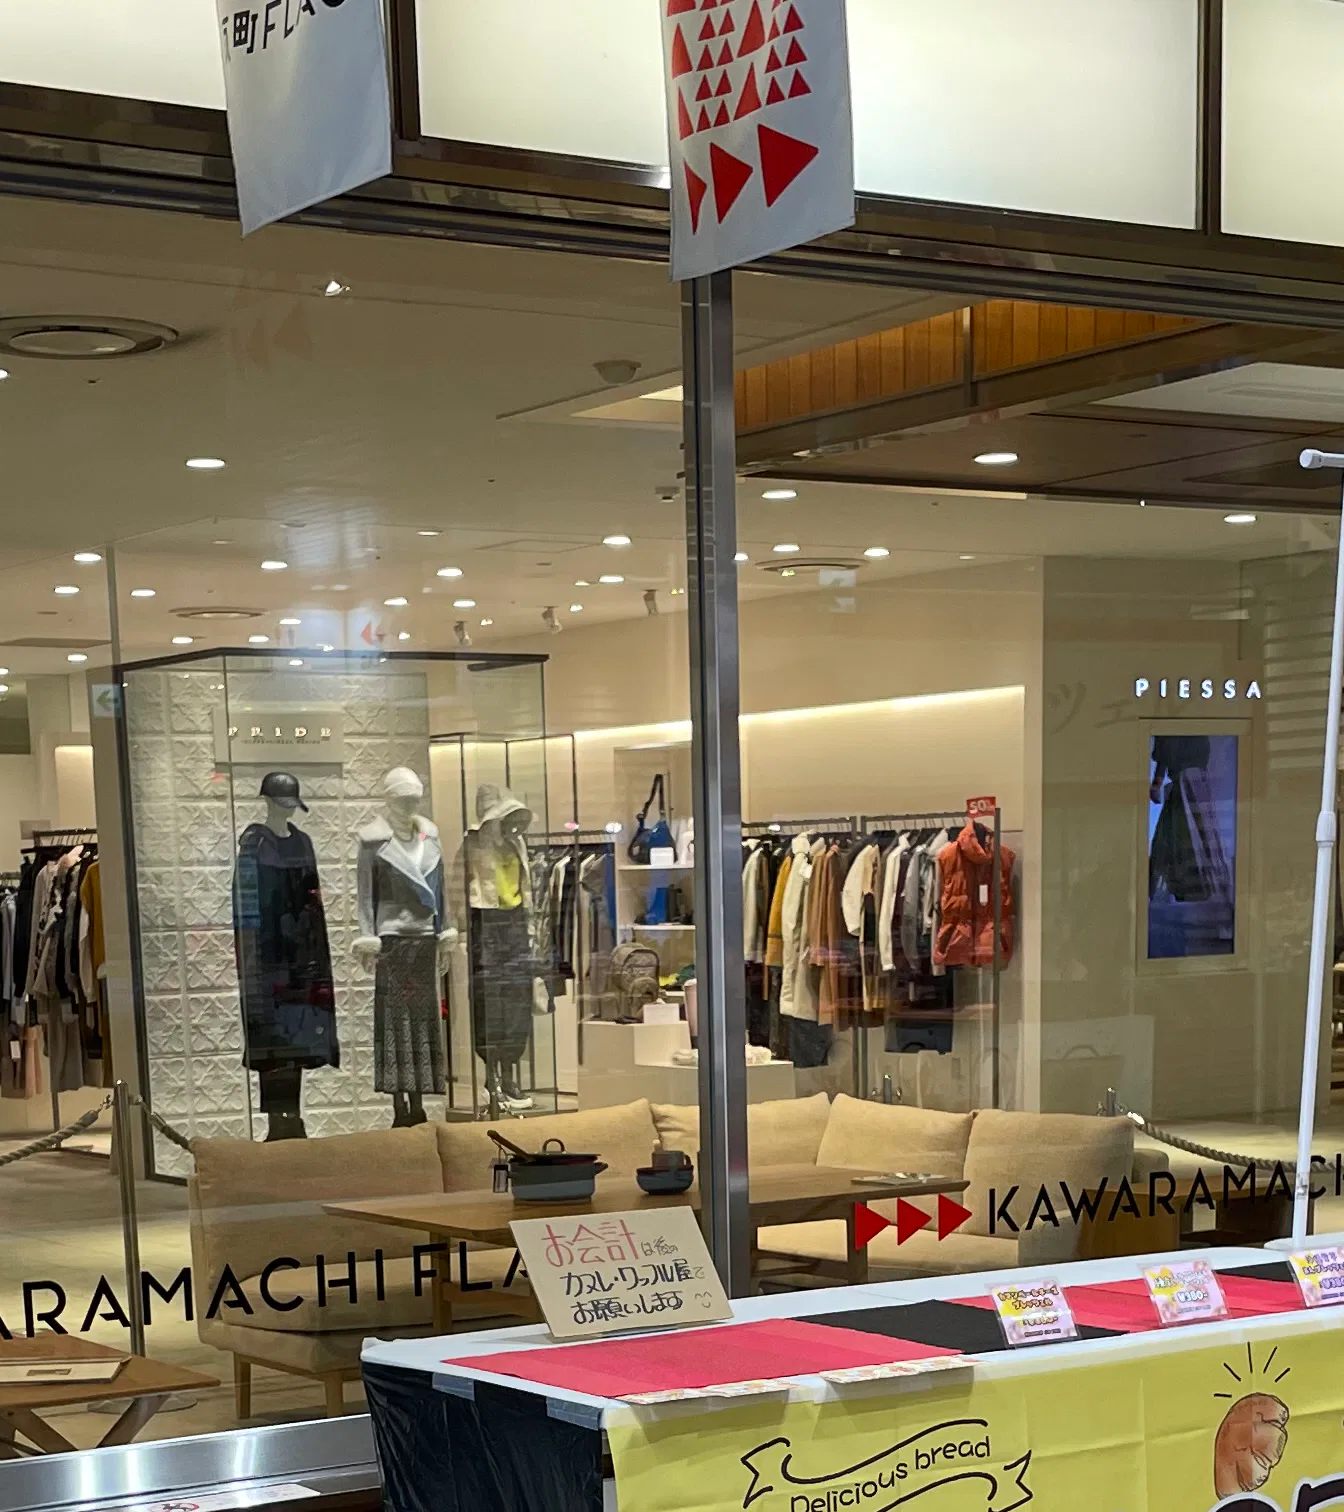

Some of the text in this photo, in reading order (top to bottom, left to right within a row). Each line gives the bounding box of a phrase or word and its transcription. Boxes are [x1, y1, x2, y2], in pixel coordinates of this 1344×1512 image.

[1135, 678, 1261, 699] PIESSA
[413, 1241, 529, 1296] FLA
[571, 1291, 684, 1325] お願いします
[915, 1436, 991, 1470] bread
